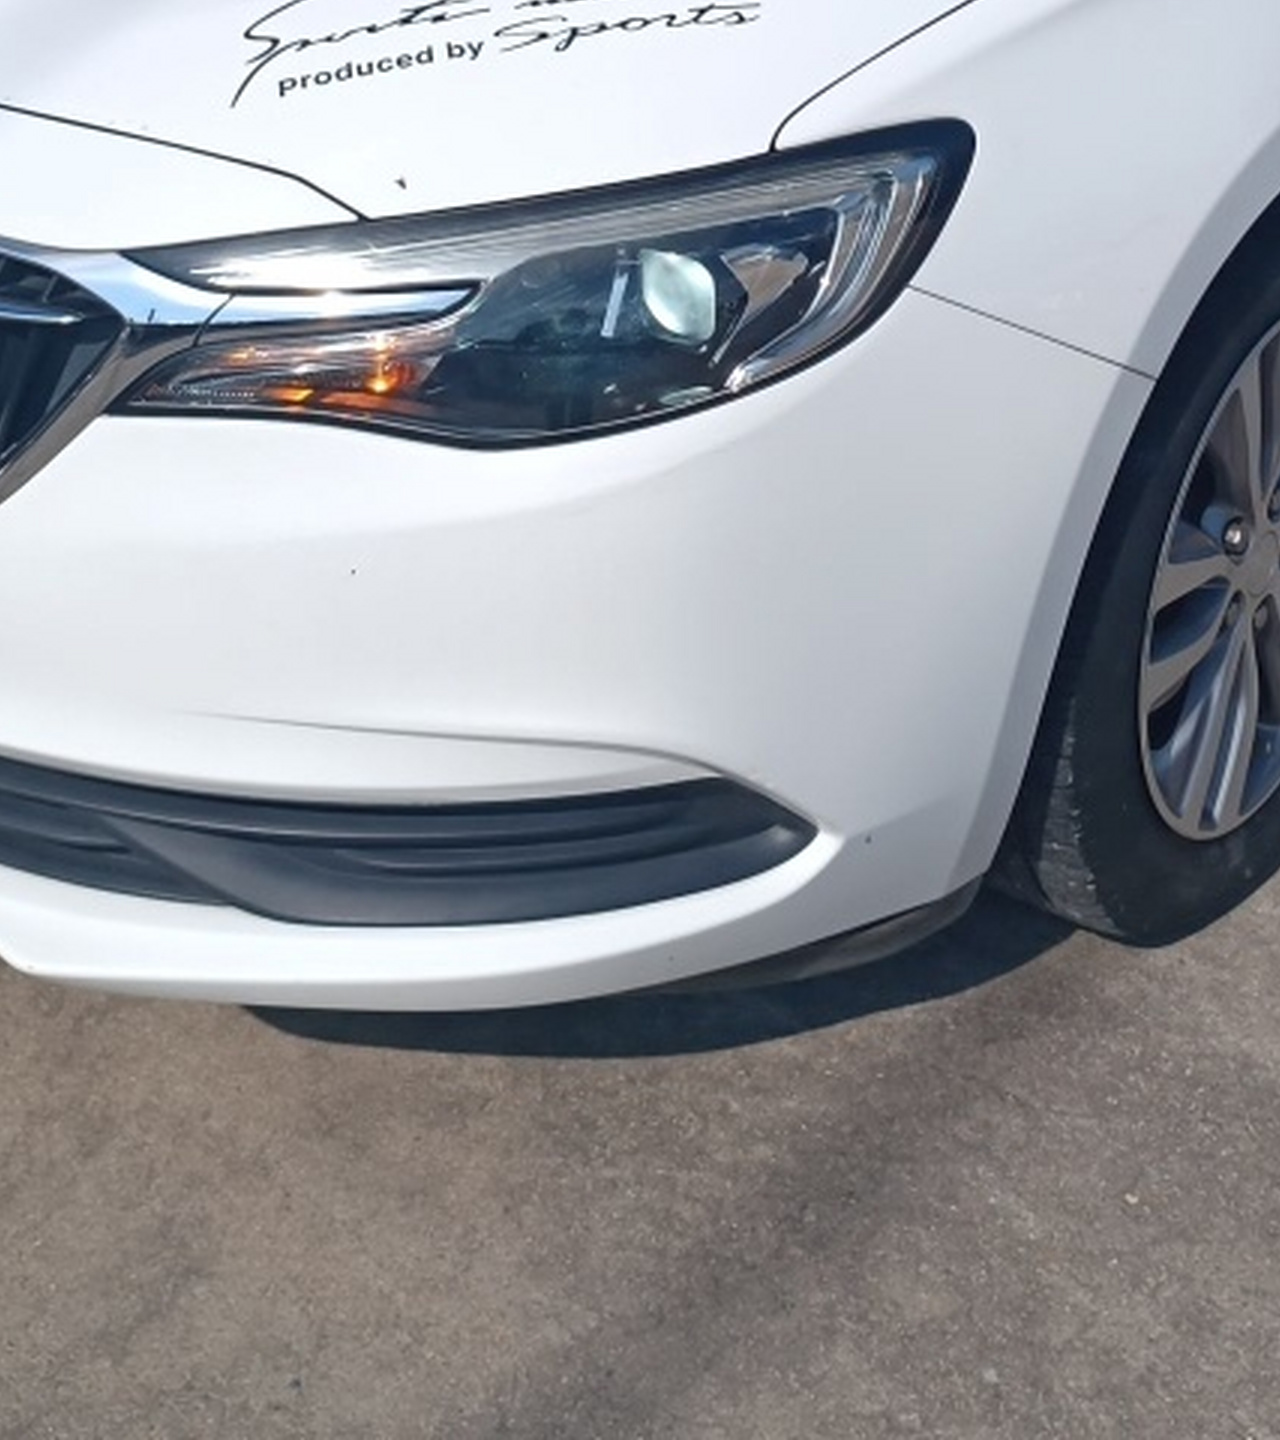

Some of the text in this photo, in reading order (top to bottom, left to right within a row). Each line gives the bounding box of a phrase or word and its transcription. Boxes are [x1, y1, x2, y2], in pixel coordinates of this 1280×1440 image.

[277, 2, 761, 98] produced by Sports
